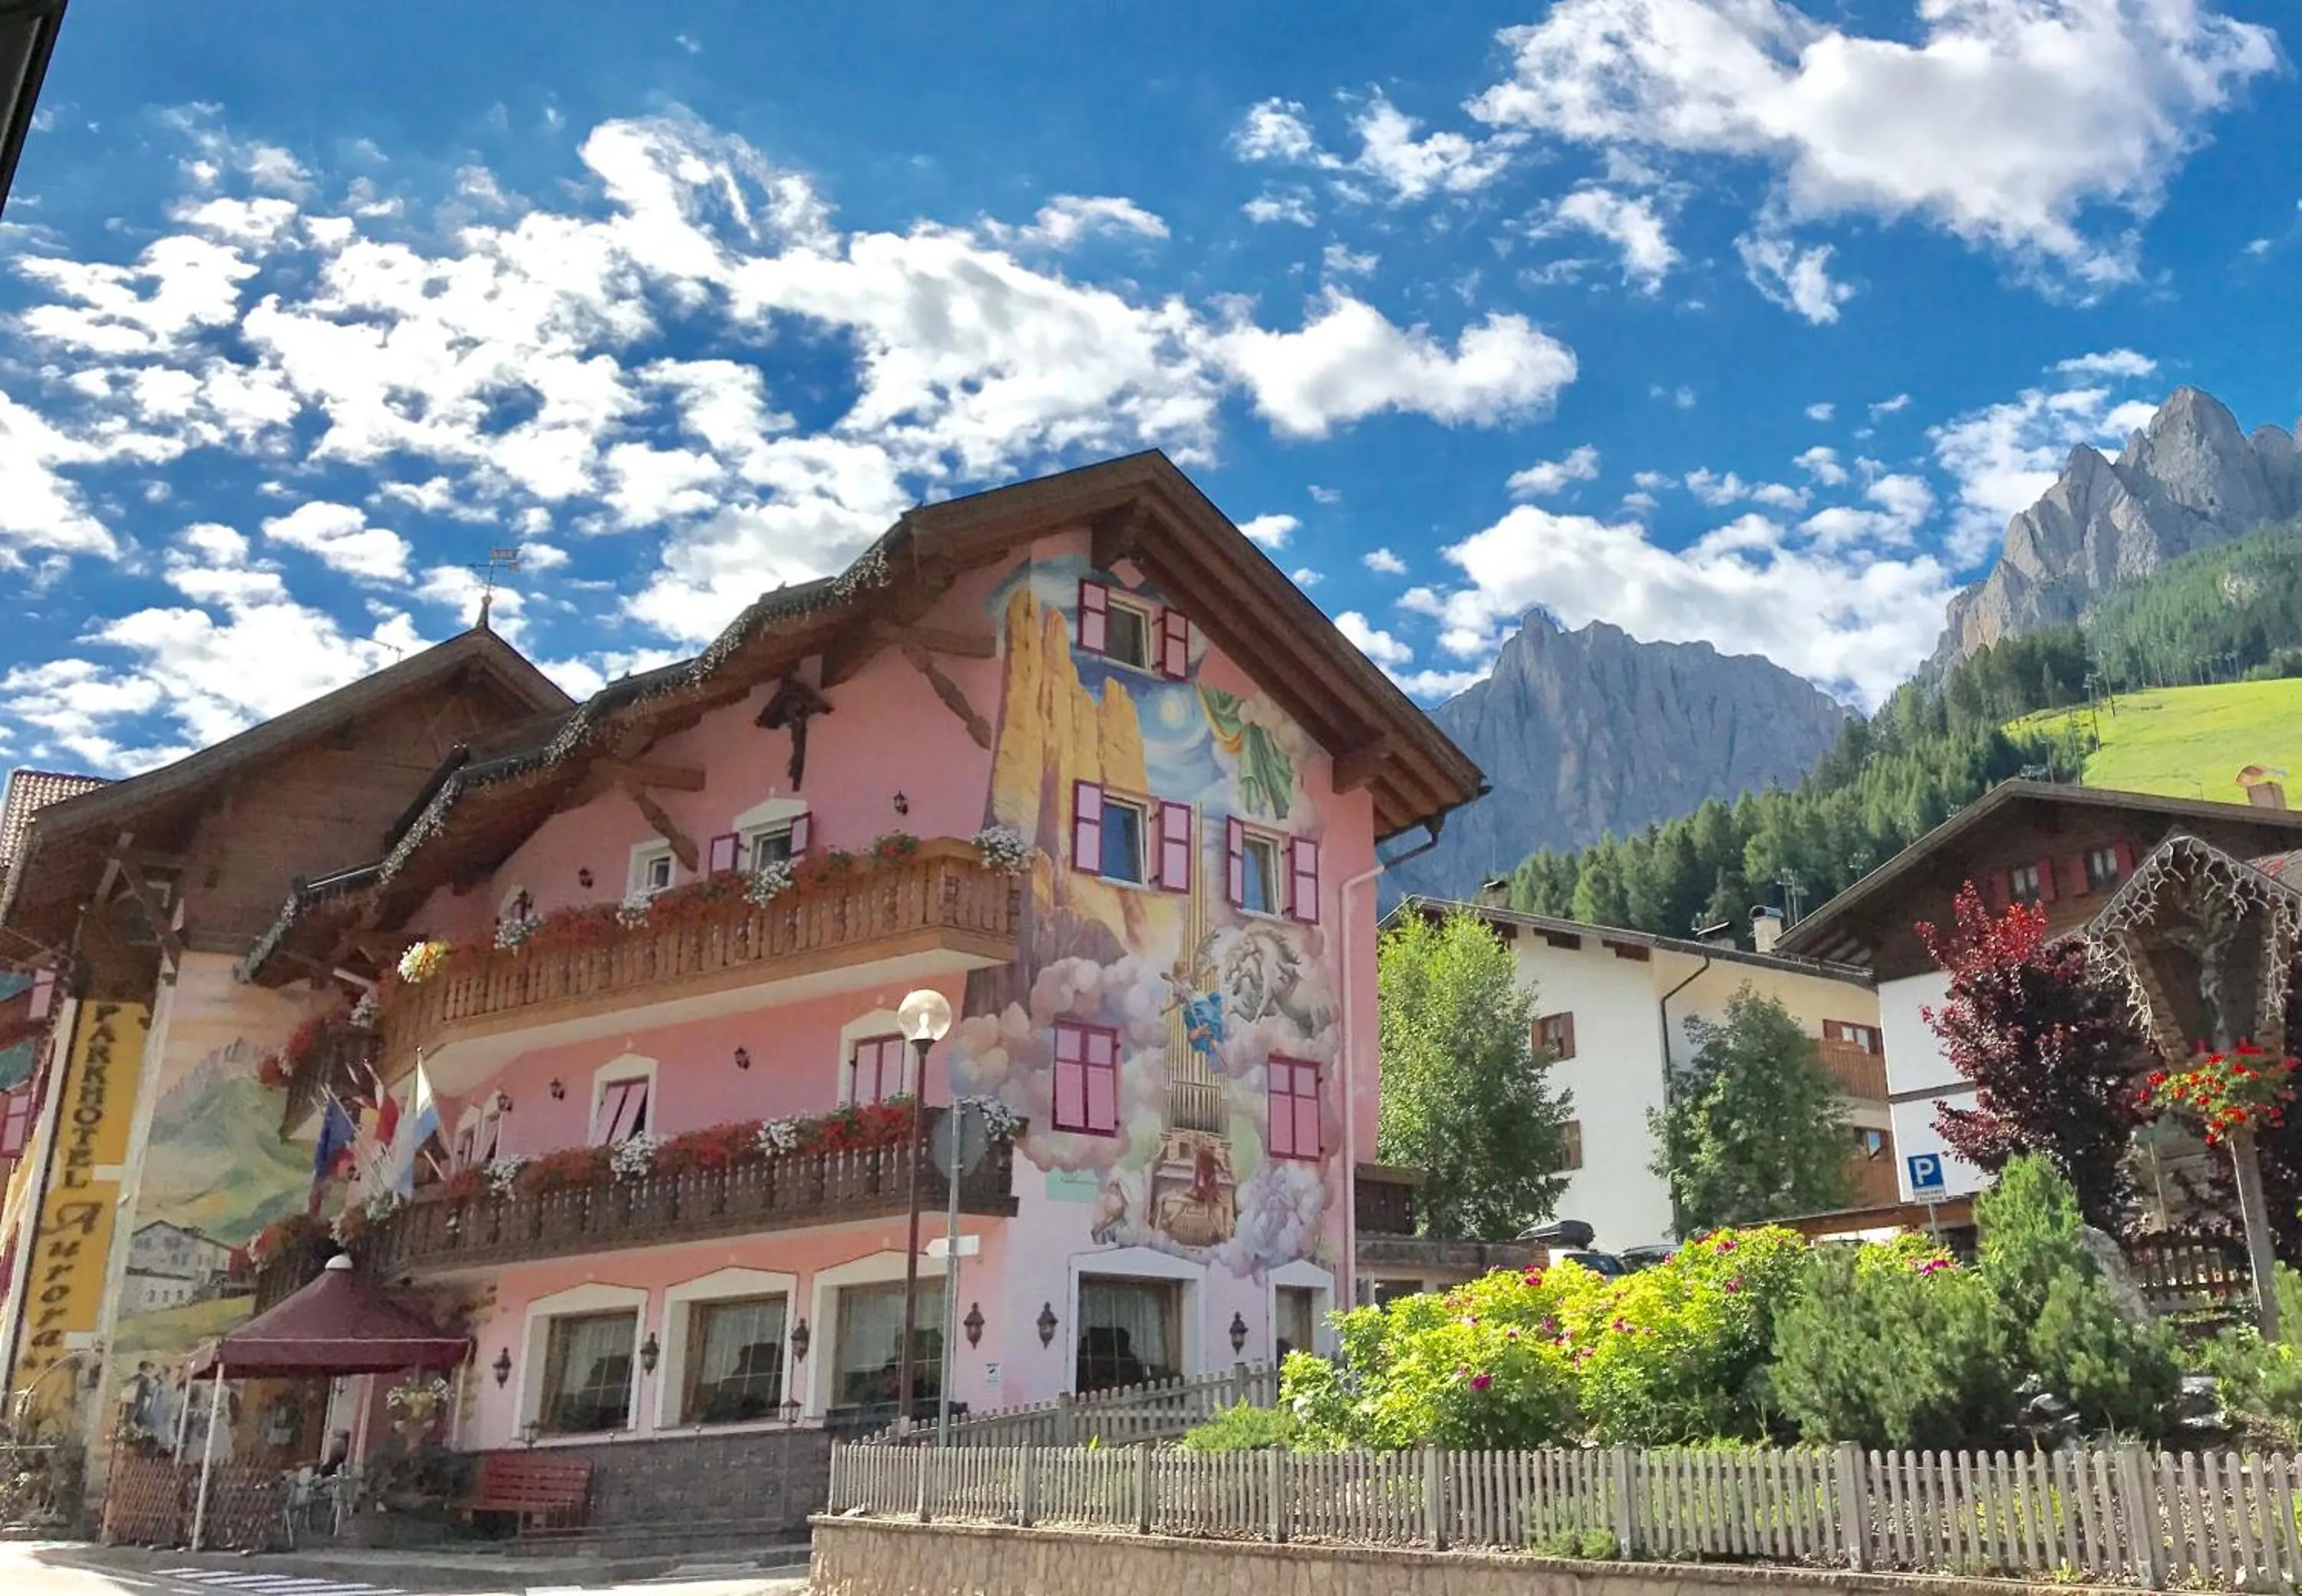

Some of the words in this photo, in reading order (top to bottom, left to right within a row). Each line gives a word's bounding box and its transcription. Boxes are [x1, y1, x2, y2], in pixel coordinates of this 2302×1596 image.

[64, 1004, 122, 1189] PARKHOTEL
[1914, 1158, 1934, 1185] P
[31, 1202, 104, 1348] Aurora
